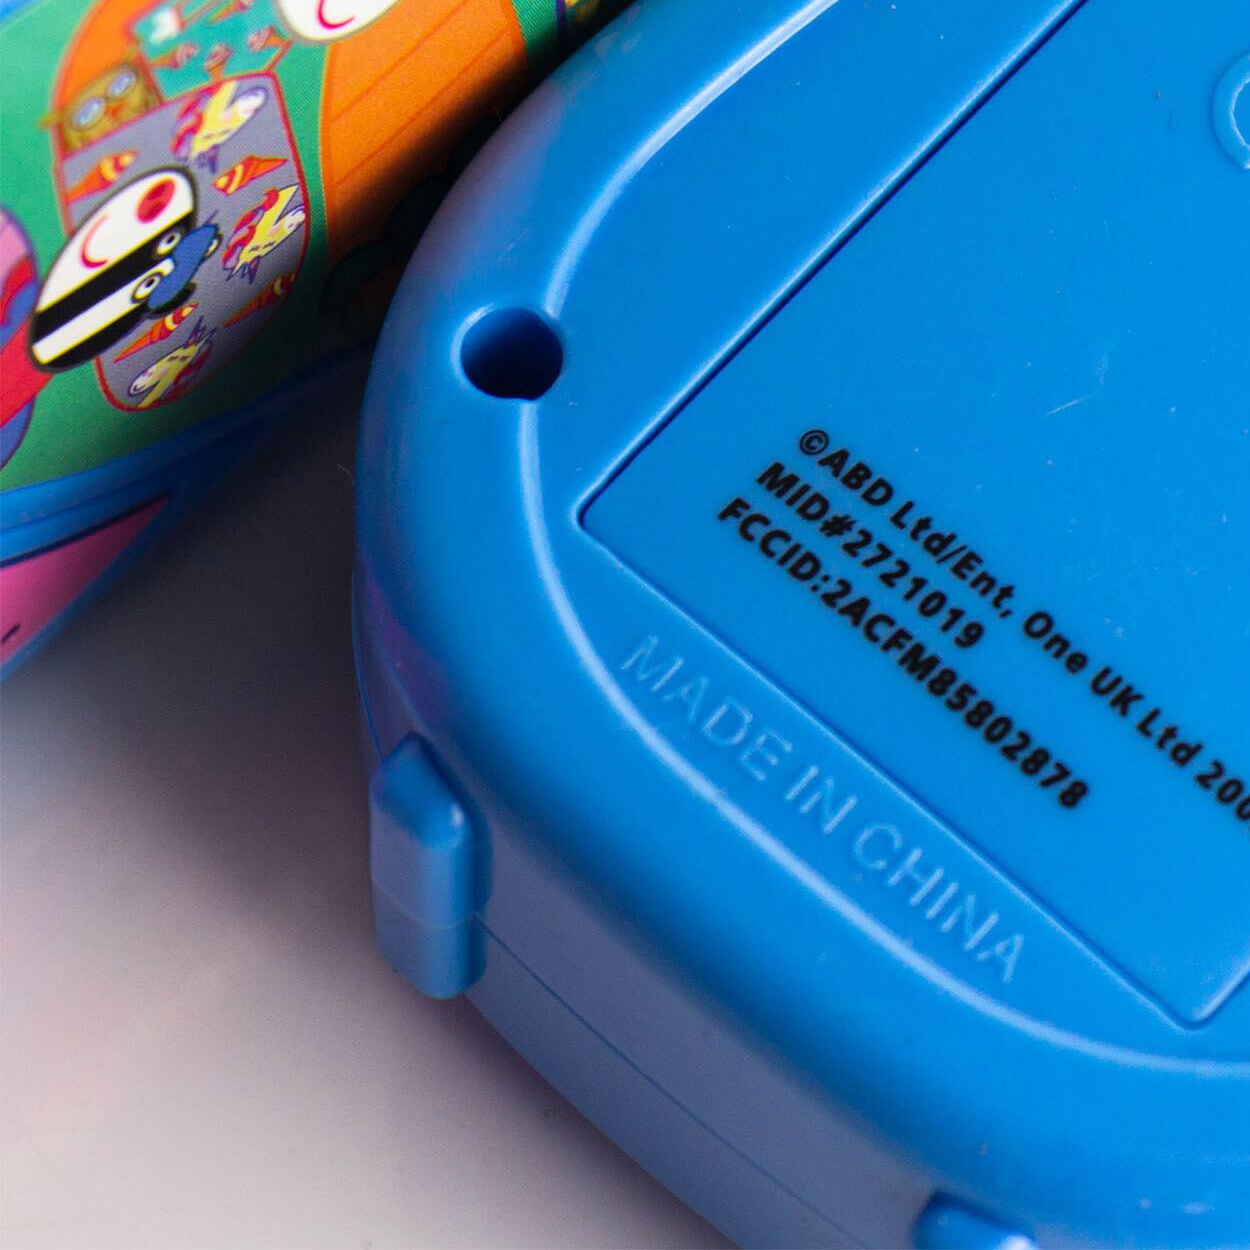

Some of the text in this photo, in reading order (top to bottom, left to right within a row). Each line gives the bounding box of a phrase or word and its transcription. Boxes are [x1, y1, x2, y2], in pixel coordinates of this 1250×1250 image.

[717, 496, 1091, 810] FCCID:2ACFM85802878
[755, 461, 985, 649] MID#2721019
[889, 500, 1015, 618] Ltd/Ent,
[1022, 611, 1088, 674] One
[1089, 666, 1144, 717] UK
[1135, 707, 1203, 768] Ltd
[621, 634, 1024, 982] MADE IN CHINA
